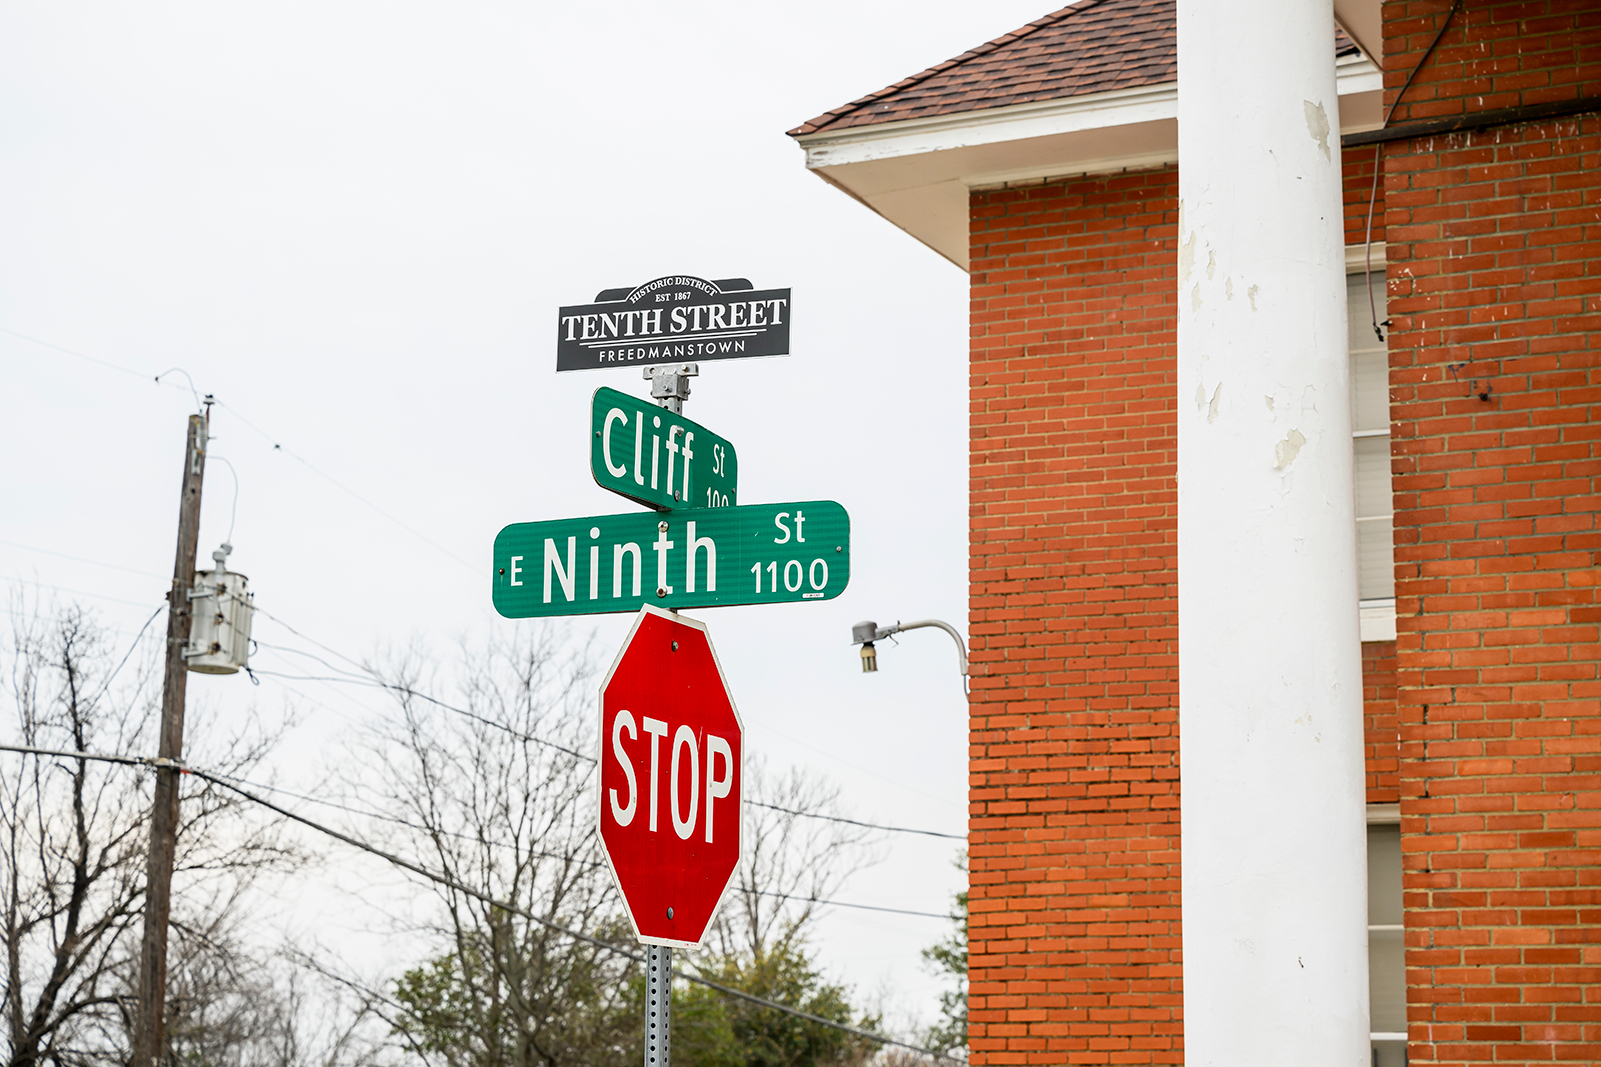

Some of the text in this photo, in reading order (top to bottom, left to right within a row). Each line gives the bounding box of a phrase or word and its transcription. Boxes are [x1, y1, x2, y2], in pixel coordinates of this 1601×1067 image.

[630, 277, 718, 304] HISTORIC DISTRICT
[655, 291, 691, 303] EST 1867
[562, 298, 787, 341] TENTH STREET
[599, 340, 745, 362] FREEDMANSTOWN
[602, 407, 725, 502] Cliff St
[510, 510, 806, 604] E Ninth St
[750, 558, 829, 594] 1100
[609, 710, 733, 843] STOP
